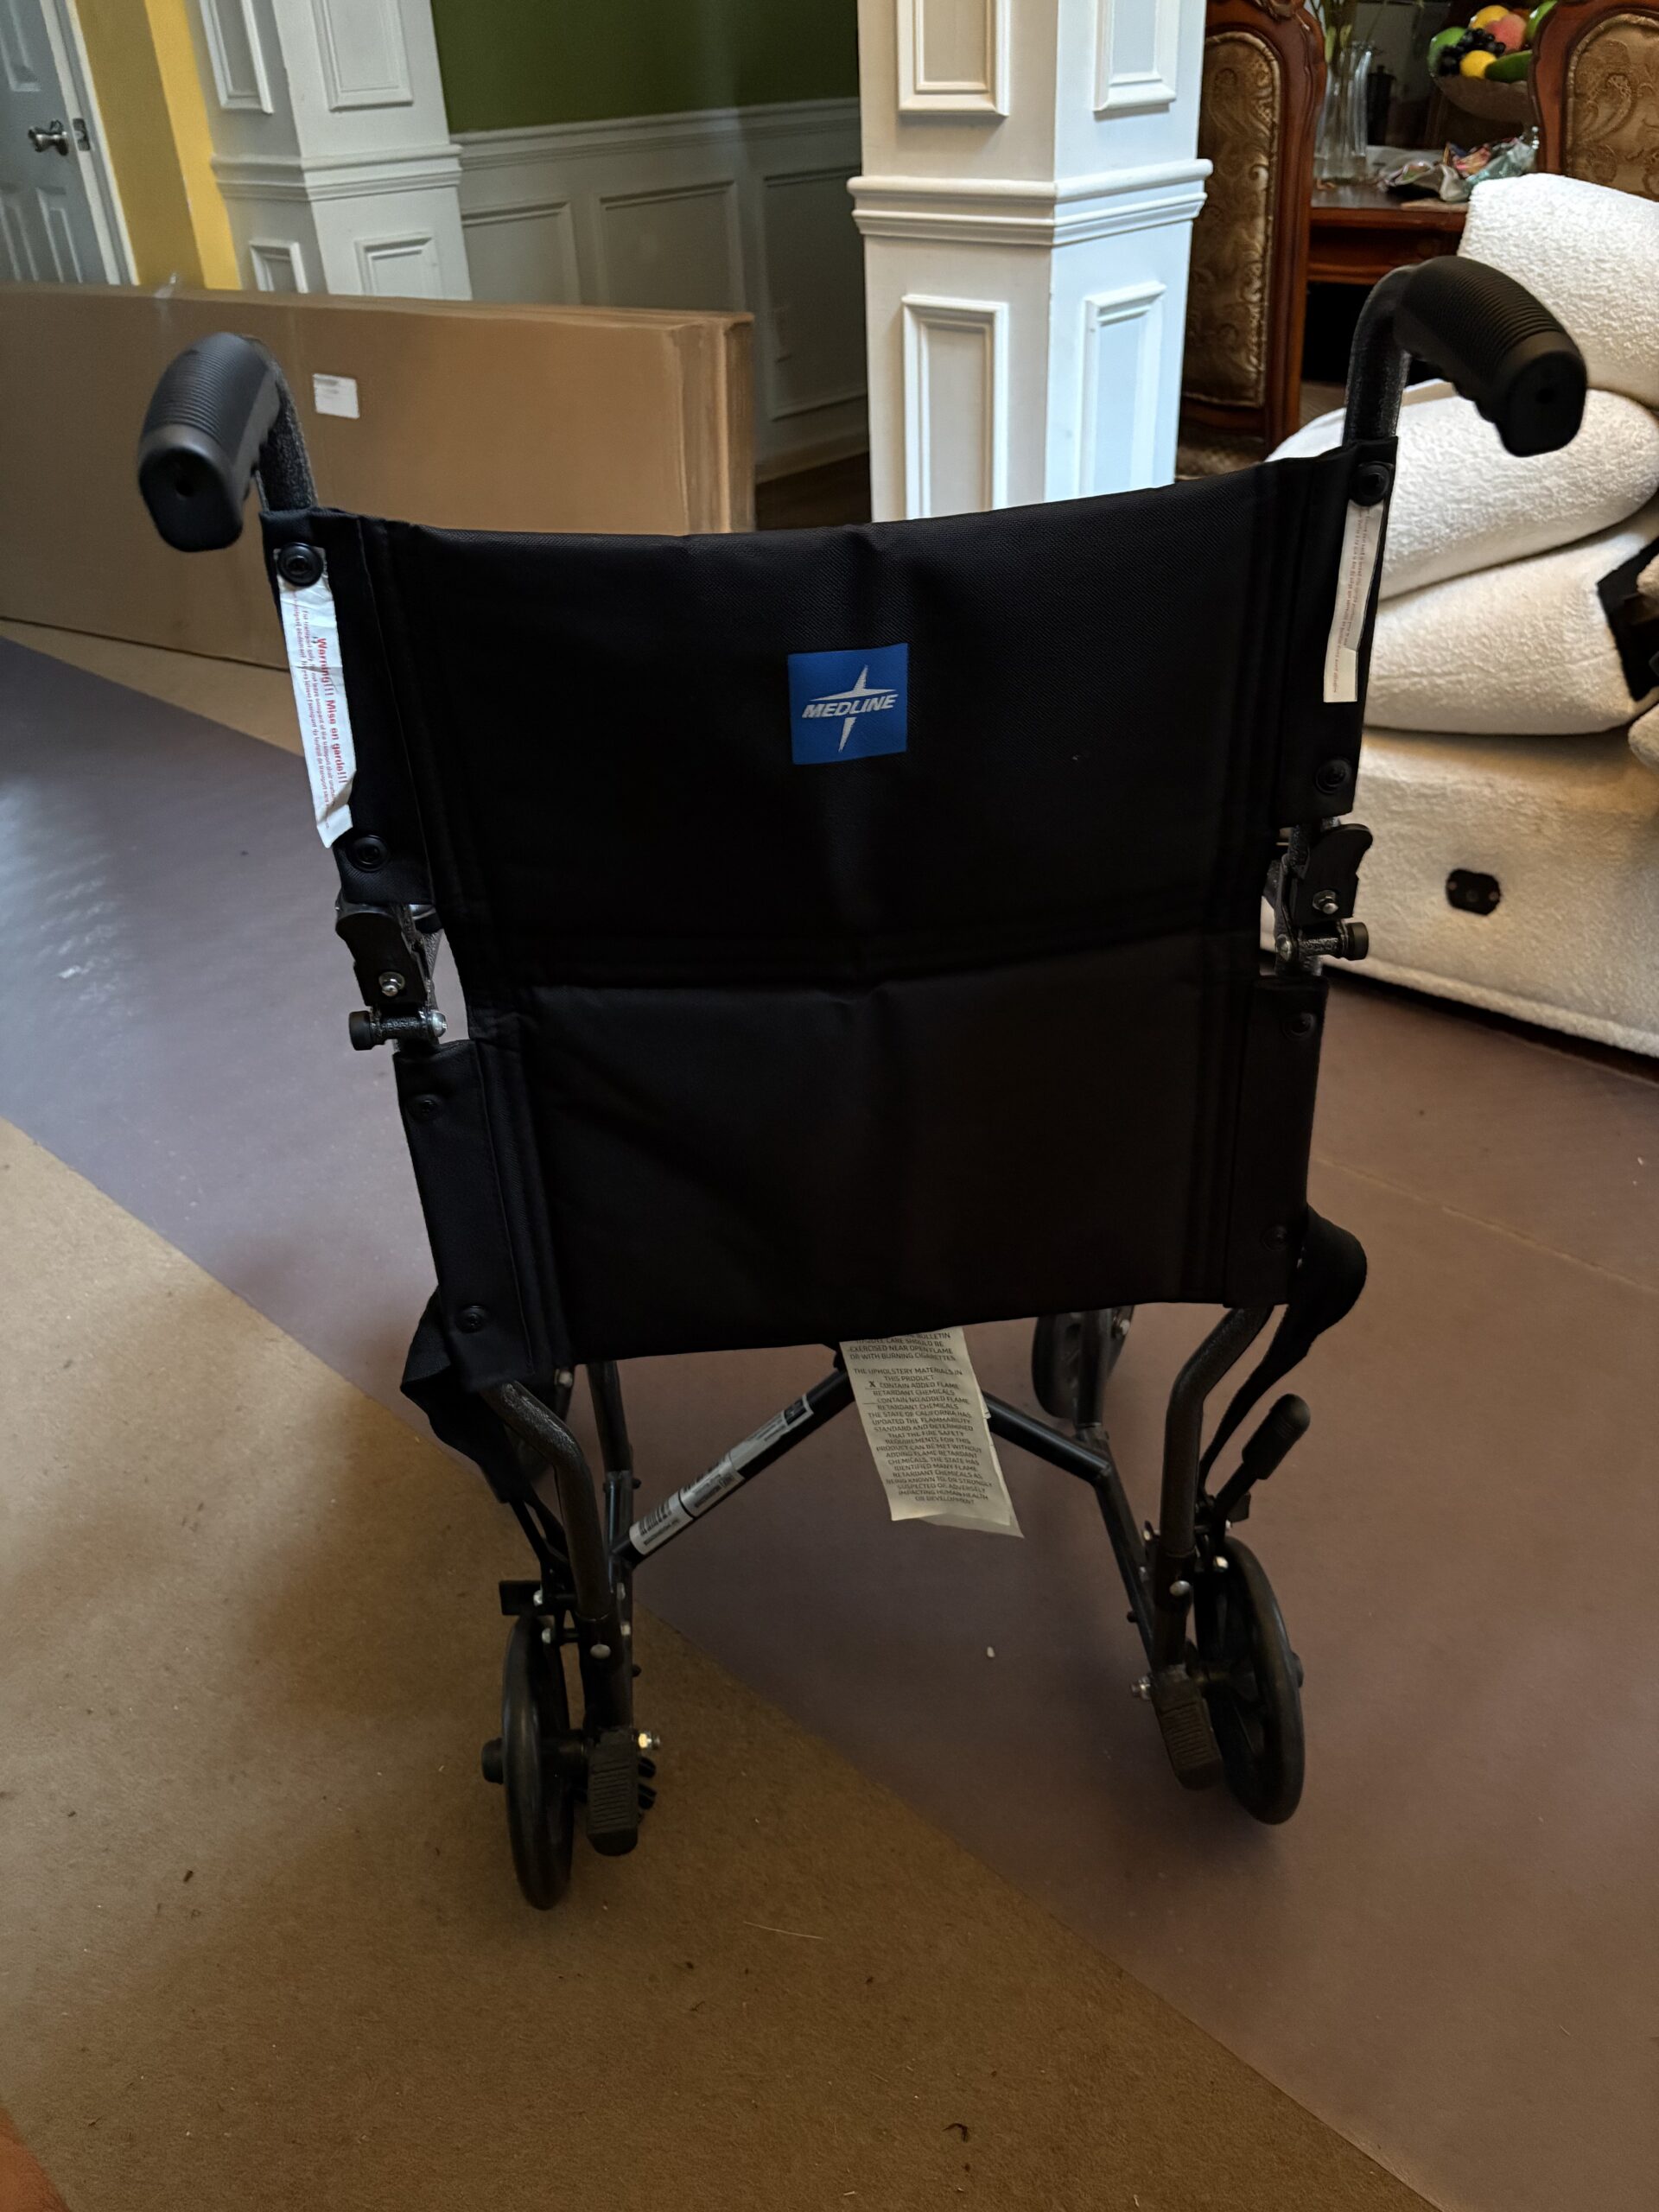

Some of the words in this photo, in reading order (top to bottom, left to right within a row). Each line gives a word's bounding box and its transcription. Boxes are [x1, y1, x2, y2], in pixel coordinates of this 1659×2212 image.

[802, 694, 899, 718] MEDLINE
[326, 699, 337, 725] Mise
[331, 728, 340, 740] en
[915, 1352, 956, 1361] CIGARETTES
[952, 1445, 982, 1453] WITHOUT
[934, 1469, 973, 1478] CHEMICALS
[960, 1478, 992, 1487] STRONGLY
[948, 1484, 986, 1493] ADVERSELY
